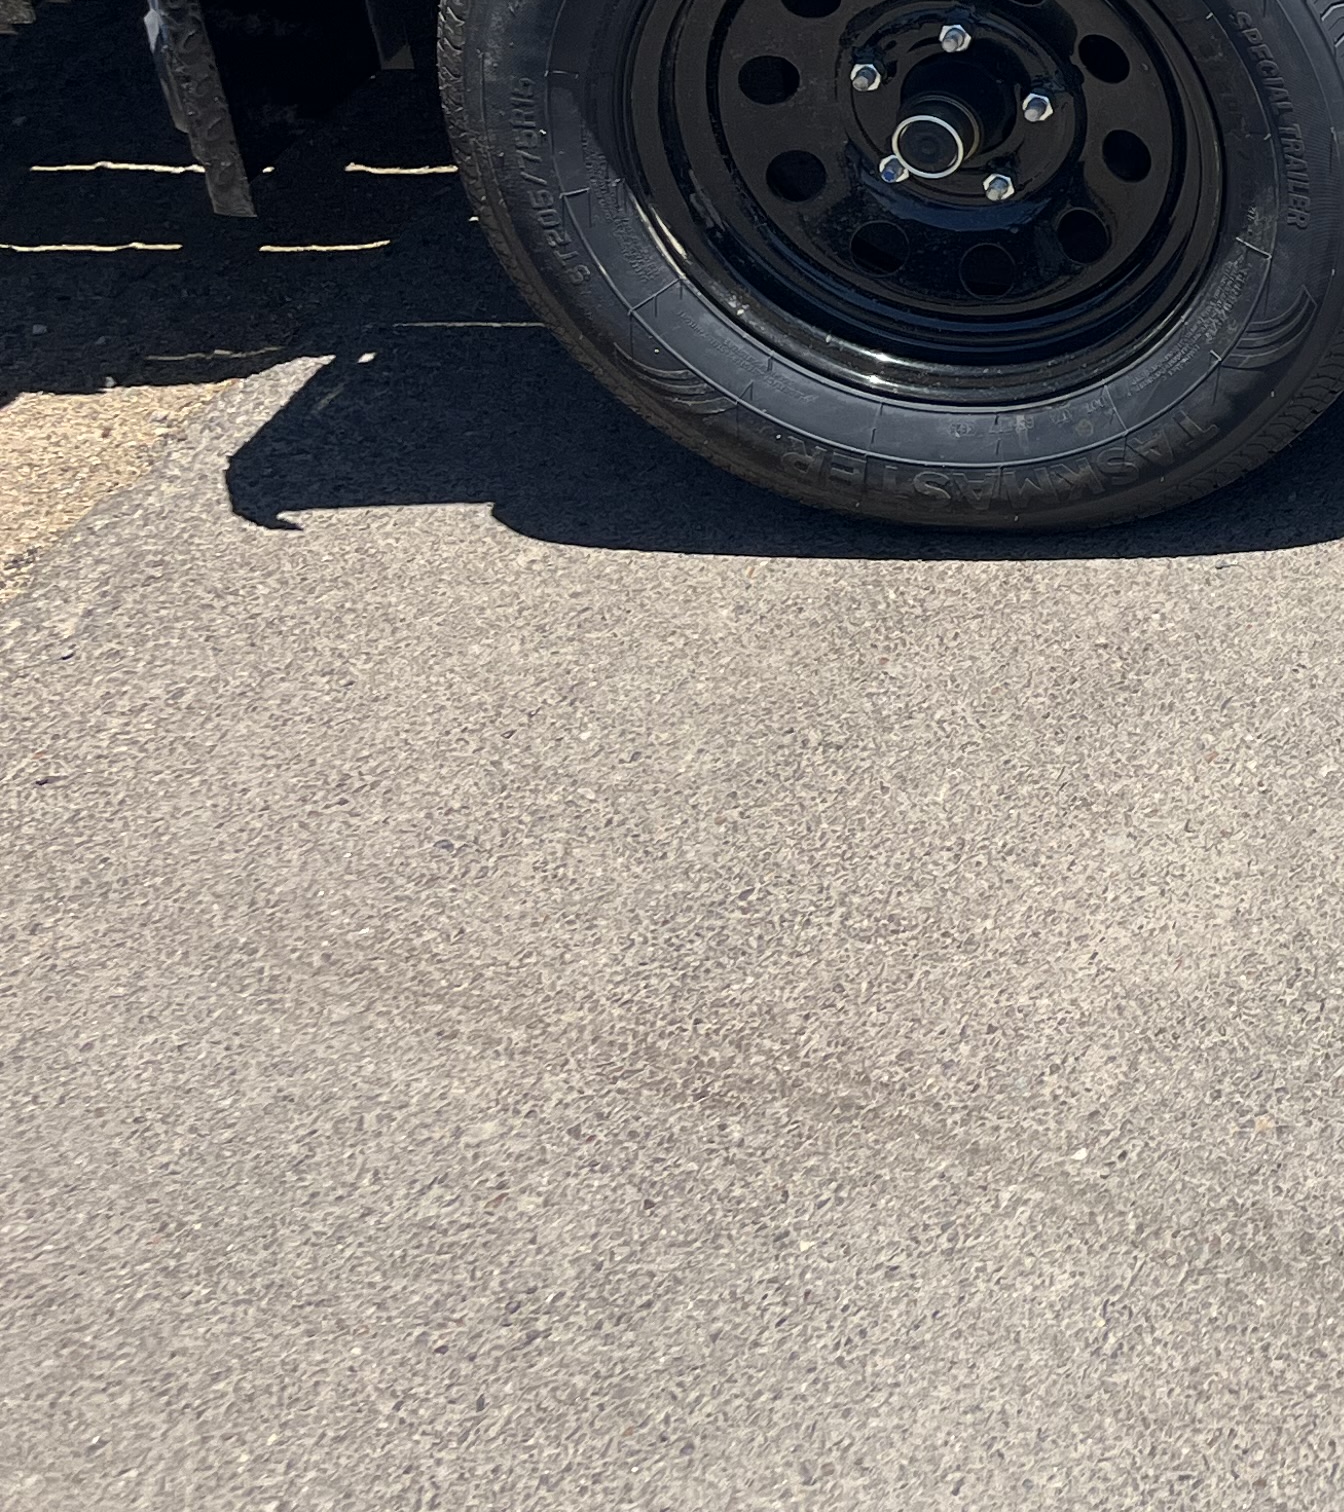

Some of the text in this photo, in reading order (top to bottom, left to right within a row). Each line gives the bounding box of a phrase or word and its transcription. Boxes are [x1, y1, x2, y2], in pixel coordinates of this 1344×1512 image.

[1228, 10, 1311, 229] SPECIAL TRAILER
[780, 406, 1221, 510] TASKMASTER
